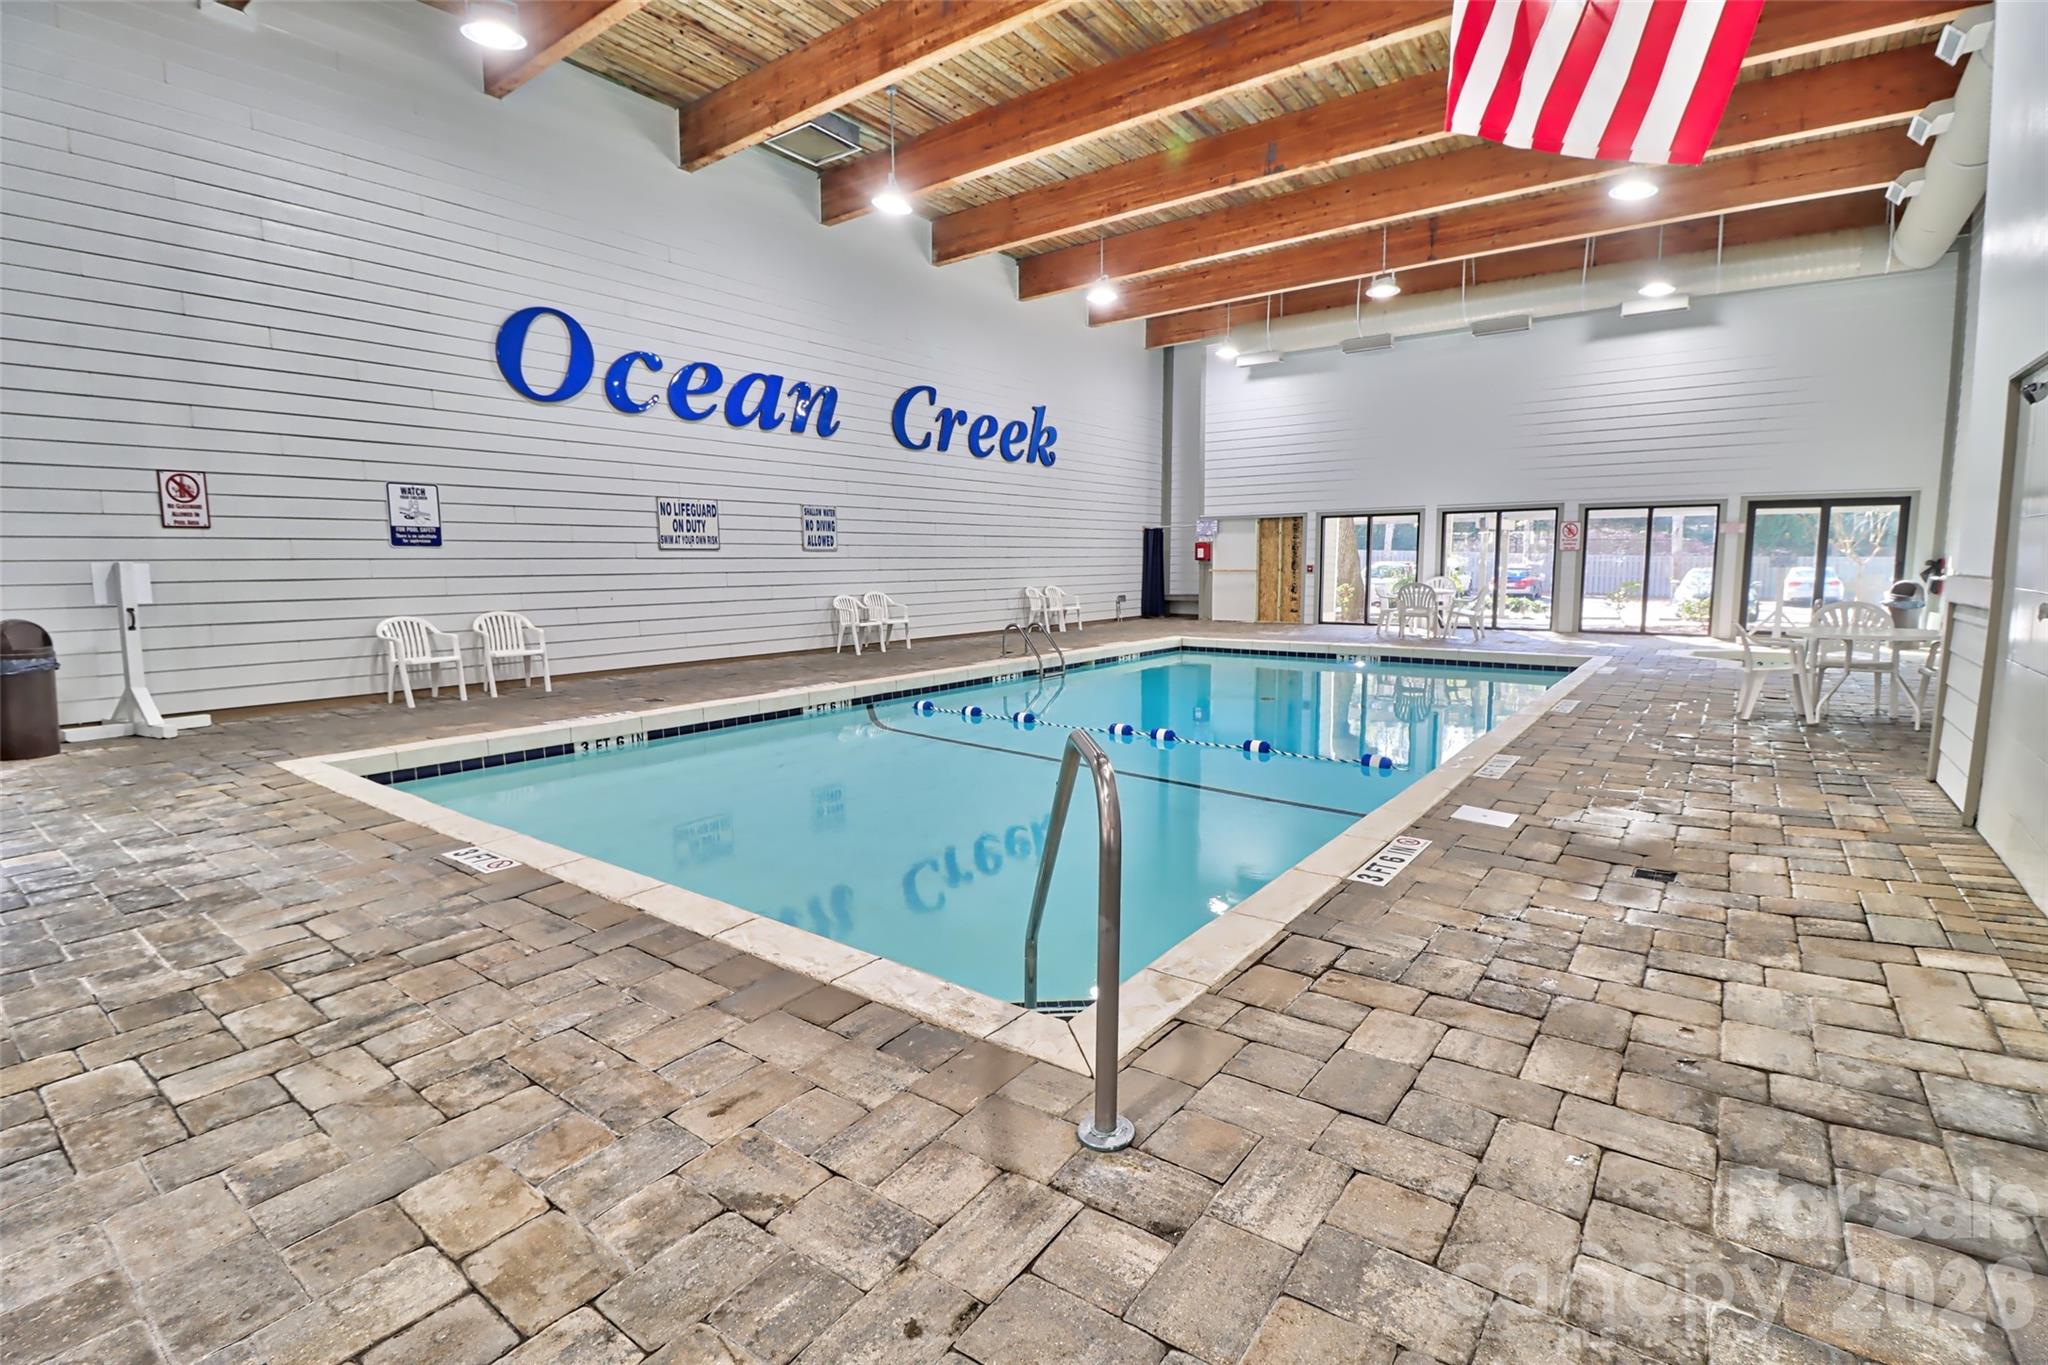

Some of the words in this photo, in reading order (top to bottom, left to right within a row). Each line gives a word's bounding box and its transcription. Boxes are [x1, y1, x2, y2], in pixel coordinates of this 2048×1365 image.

[495, 306, 841, 439] Ocean
[891, 384, 1058, 468] Creek
[400, 487, 426, 496] WATCH
[660, 501, 672, 516] NO
[673, 502, 717, 518] LIFEGUARD
[804, 508, 822, 516] SHALLOW
[823, 508, 836, 517] WATER
[672, 518, 684, 533] ON
[686, 519, 707, 533] DUTY
[805, 519, 814, 531] NO
[816, 520, 836, 532] DIVING
[660, 535, 674, 544] SWIM
[674, 535, 681, 544] AT
[681, 535, 695, 545] YOUR
[695, 535, 707, 545] OWN
[707, 535, 718, 545] RISK
[807, 534, 835, 547] ALLOWED
[580, 741, 589, 752] 3
[595, 737, 610, 750] FT
[616, 735, 625, 747] 6
[631, 732, 644, 744] IN
[453, 848, 480, 857] 3
[1387, 844, 1417, 857] IN
[463, 853, 499, 864] FT
[1379, 855, 1406, 864] 6
[1365, 862, 1398, 876] FT
[1356, 873, 1385, 883] 3
